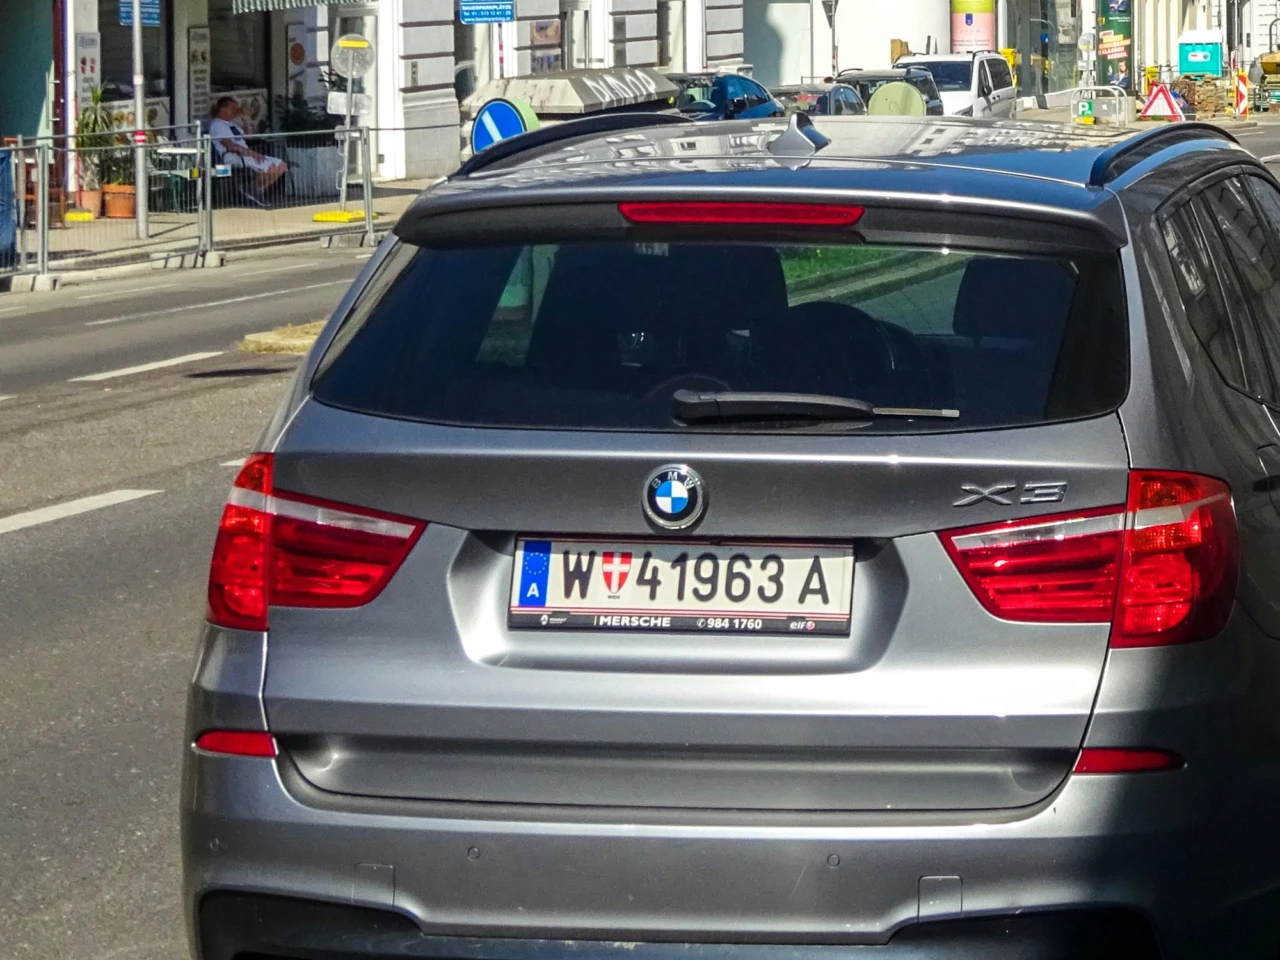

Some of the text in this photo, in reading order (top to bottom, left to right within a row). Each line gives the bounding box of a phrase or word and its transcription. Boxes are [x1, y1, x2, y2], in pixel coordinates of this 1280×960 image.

[1079, 102, 1089, 115] P
[651, 471, 695, 489] BMW
[952, 482, 1068, 508] X3
[527, 549, 830, 605] A W 41963 A
[599, 616, 671, 627] MERSCHE
[707, 618, 730, 628] 984
[733, 619, 763, 629] 1760
[789, 621, 807, 630] elf
